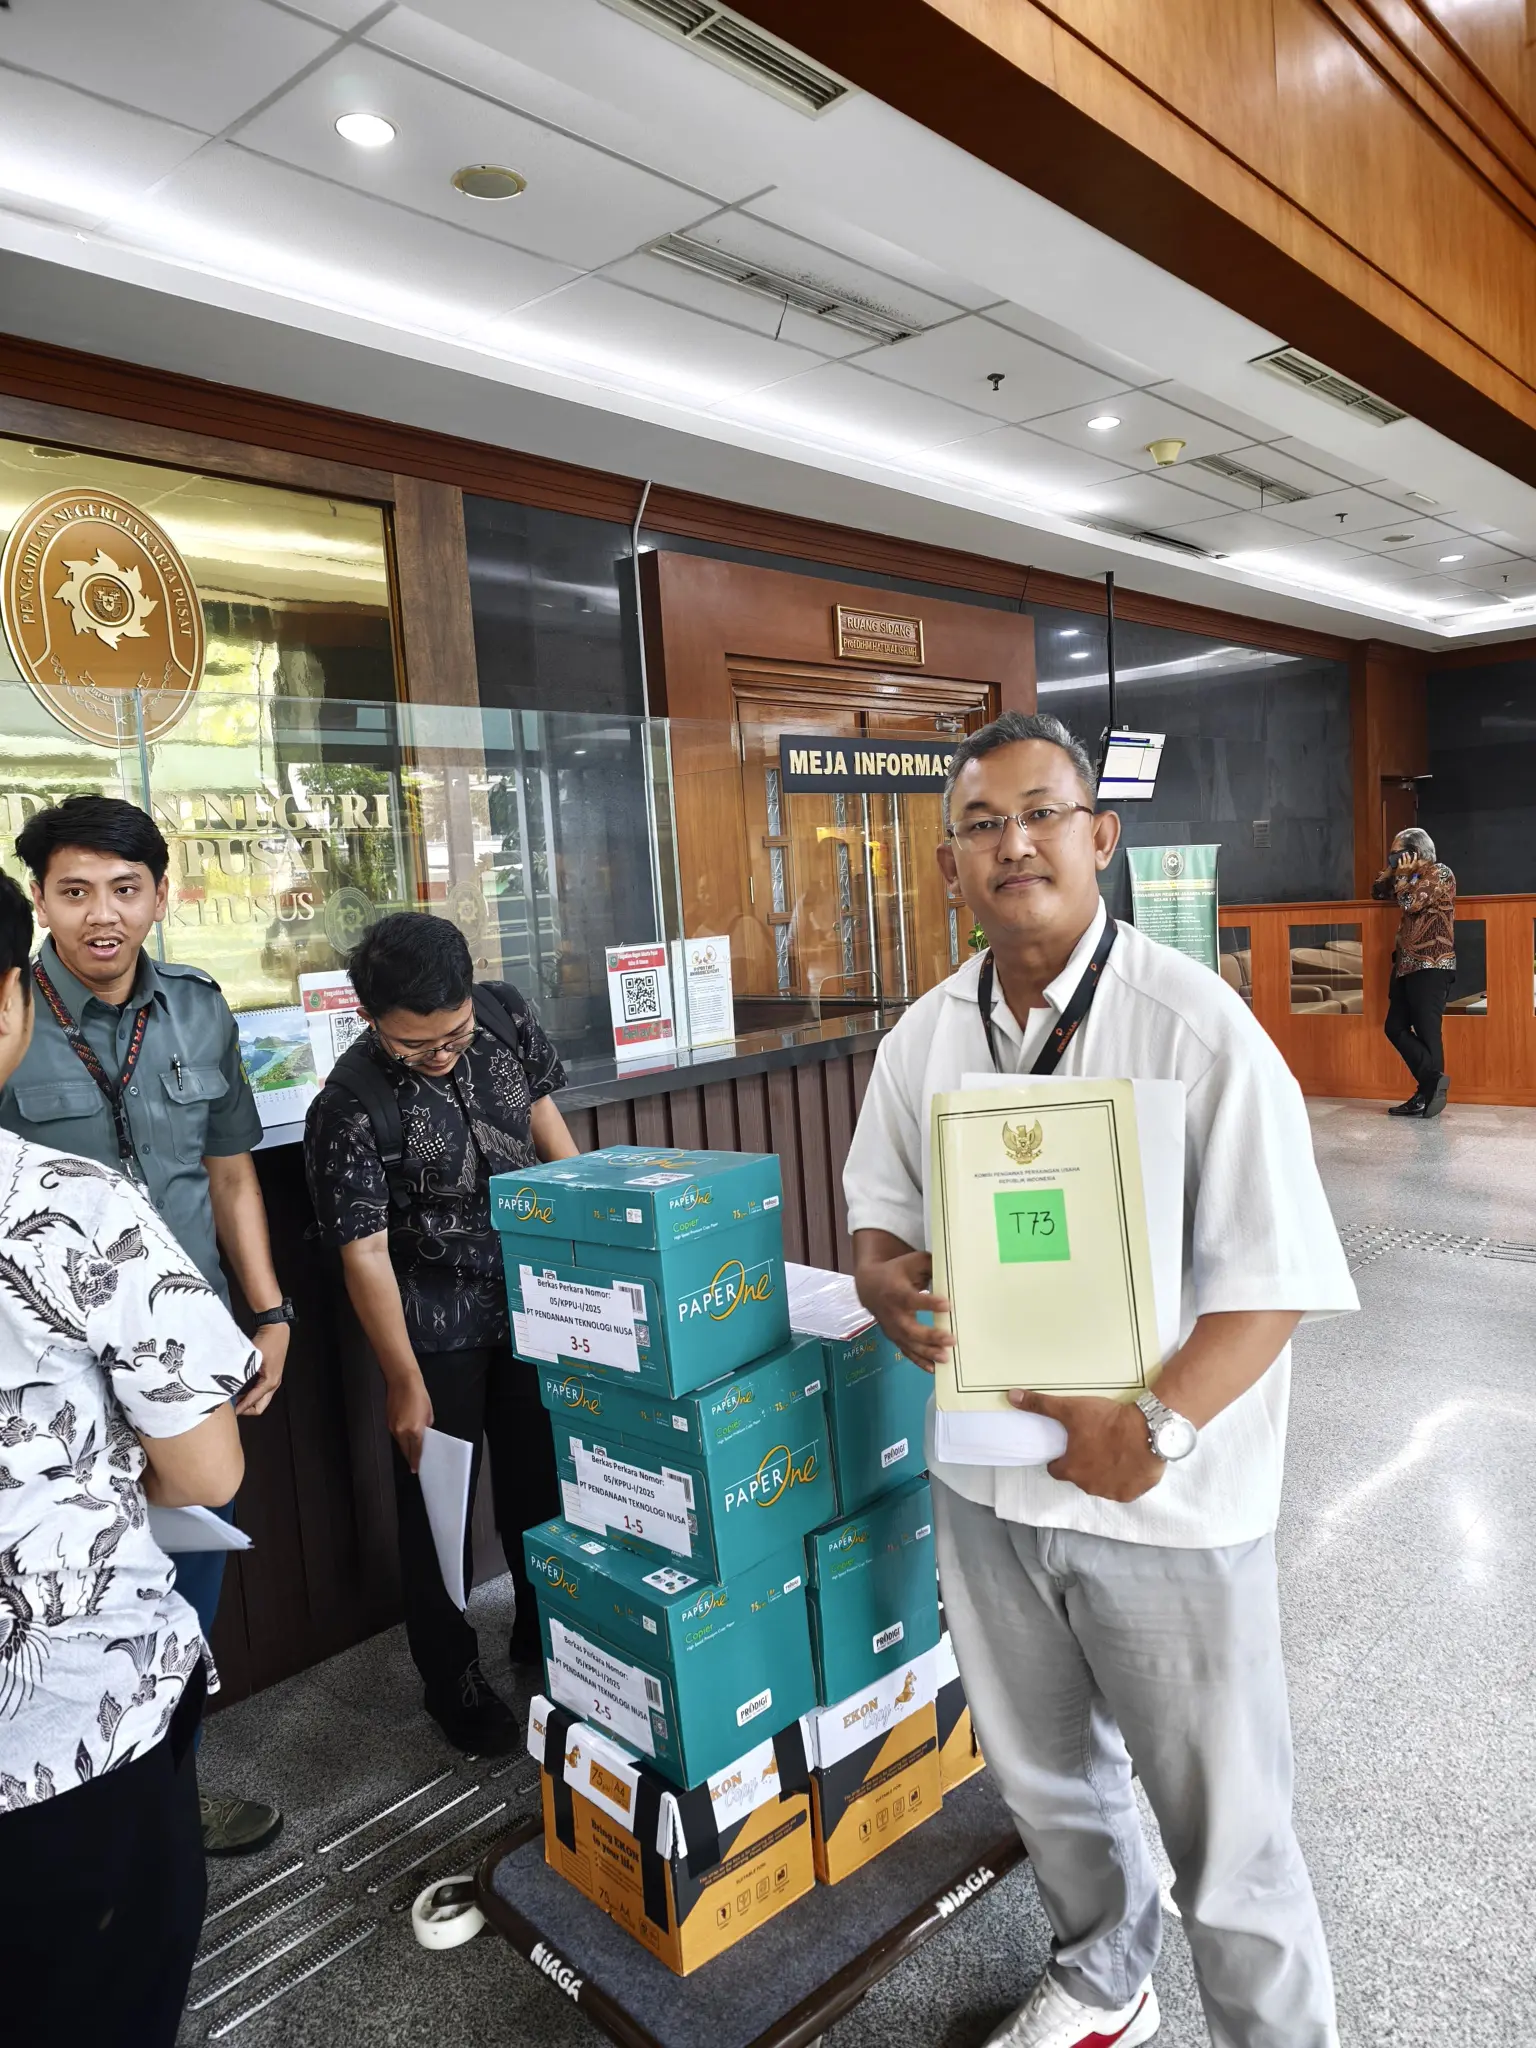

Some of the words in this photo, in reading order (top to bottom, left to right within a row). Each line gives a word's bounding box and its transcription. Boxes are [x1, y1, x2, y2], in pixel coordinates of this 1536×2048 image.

[18, 519, 56, 625] PENGADILAN
[52, 503, 118, 525] NEGERI
[120, 515, 178, 584] JAKARTA
[172, 588, 192, 638] PUSAT
[846, 616, 879, 632] RUANG
[880, 620, 912, 638] SIDANG
[789, 749, 848, 775] MEJA
[854, 751, 954, 776] INFORMAS
[200, 793, 393, 830] NEGERI
[180, 837, 332, 877] PUSAT
[168, 892, 316, 928] KHUSUS
[672, 1217, 699, 1233] Copier
[1009, 1210, 1055, 1236] T73
[537, 1278, 559, 1290] Berkas
[559, 1282, 584, 1295] Perkara
[584, 1288, 612, 1300] Nomor:
[549, 1296, 602, 1315] 05/KPPU-I/2025
[526, 1307, 534, 1316] PT
[534, 1309, 574, 1325] PENDANAAN
[574, 1317, 613, 1333] TEKNOLOGI
[613, 1325, 633, 1337] NUSA
[570, 1335, 591, 1353] 3-5
[715, 1419, 741, 1438] Copier
[591, 1454, 613, 1469] Berkas
[613, 1462, 638, 1478] Perkara
[639, 1471, 665, 1487] Nomor:
[603, 1474, 656, 1500] 05/KPPU-I/2025
[579, 1480, 587, 1490] PT
[587, 1483, 628, 1505] PENDANAAN
[627, 1498, 666, 1518] TEKNOLOGI
[666, 1512, 686, 1525] NUSA
[623, 1515, 644, 1534] 1-5
[685, 1623, 713, 1644] Copier
[563, 1635, 583, 1652] Berkas
[583, 1645, 605, 1667] Perkara
[555, 1657, 562, 1667] PT
[562, 1661, 597, 1690] PENDANAAN
[597, 1684, 631, 1711] TEKNOLOGI
[630, 1704, 648, 1721] NUSA
[593, 1699, 612, 1721] 2-5
[842, 1697, 879, 1729] EKON
[862, 1703, 892, 1731] Copy
[591, 1766, 603, 1786] 75
[614, 1780, 625, 1797] A4
[709, 1771, 743, 1801] KON
[724, 1777, 759, 1808] Copy
[591, 1818, 613, 1845] Bring
[935, 1866, 996, 1919] NIAGA
[530, 1941, 584, 2003] NIAGA
